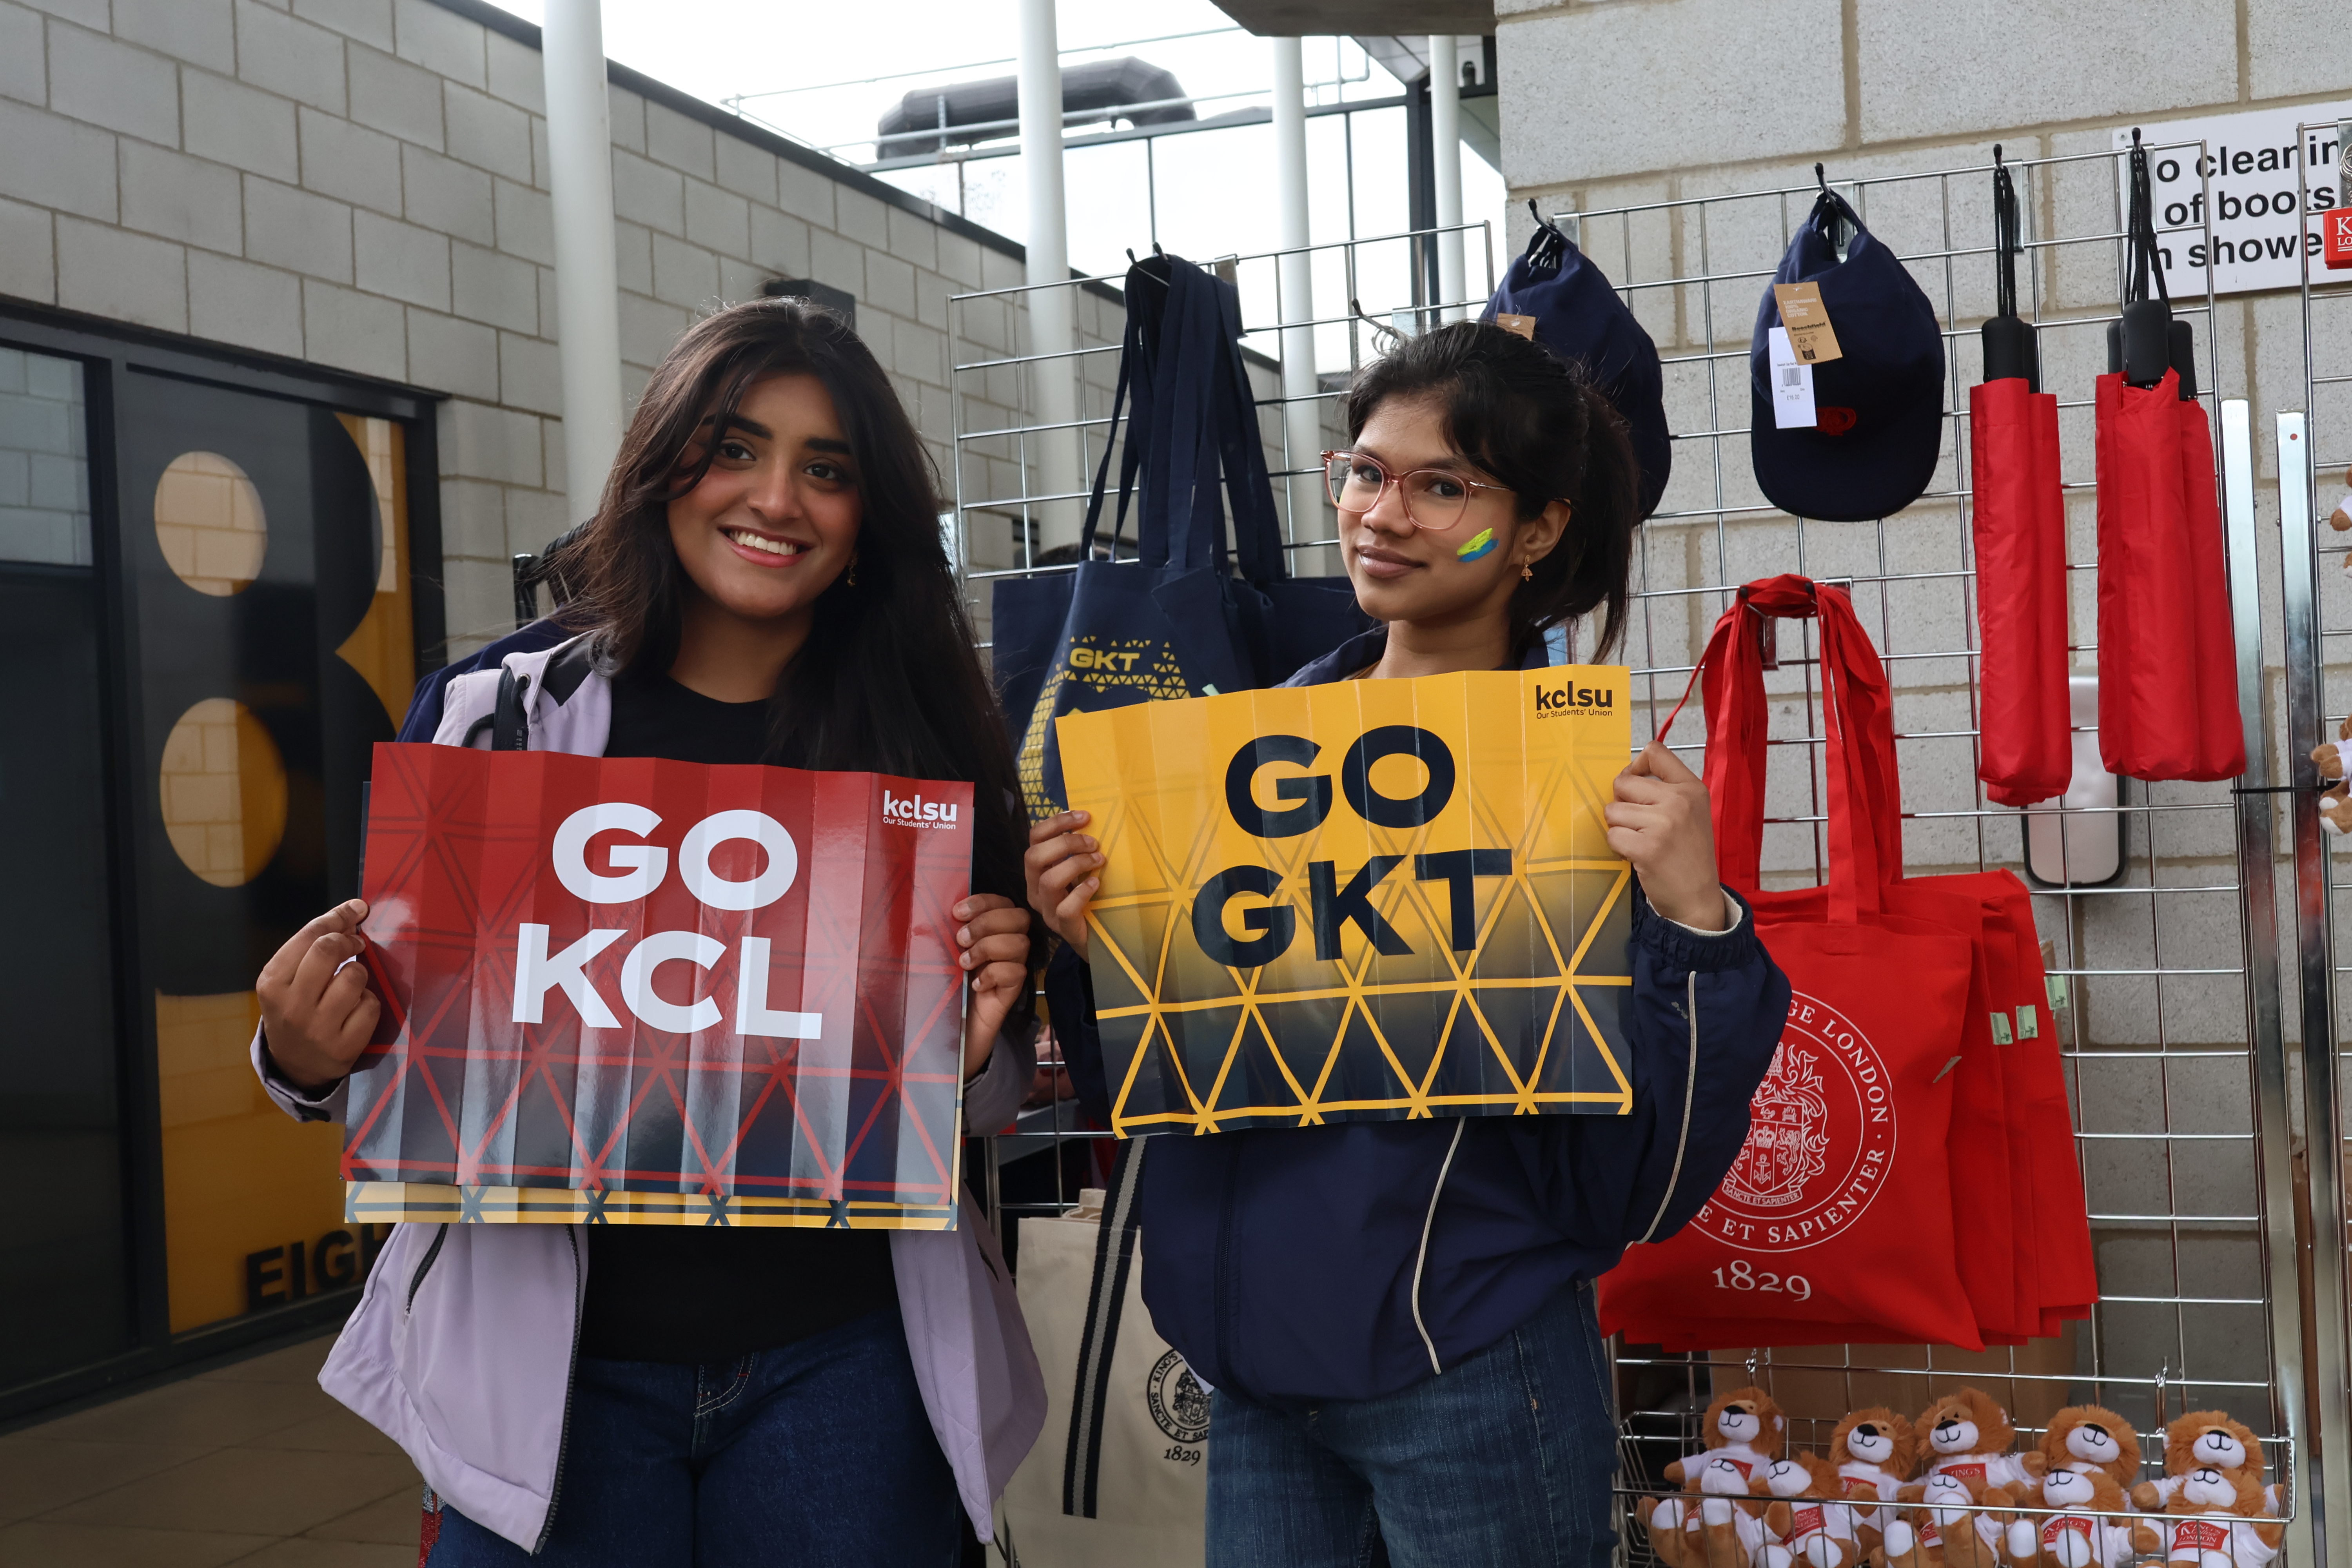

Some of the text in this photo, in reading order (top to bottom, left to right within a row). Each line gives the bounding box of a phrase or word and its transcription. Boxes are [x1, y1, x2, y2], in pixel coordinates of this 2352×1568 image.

[2157, 136, 2339, 182] o cleanin
[2164, 186, 2335, 226] of boots
[2188, 232, 2323, 268] showe
[1069, 647, 1140, 671] GKT
[1536, 681, 1612, 710] kclsu
[1551, 709, 1586, 717] Students'
[1225, 725, 1455, 838] GO
[884, 790, 957, 822] kclsu
[897, 818, 931, 828] Students'
[552, 802, 798, 911] GO
[1192, 848, 1512, 968] GKT
[512, 922, 822, 1040] KCL
[1822, 1019, 1888, 1123] LONDON
[1722, 1149, 1885, 1244] ET SAPIENTER
[1726, 1186, 1751, 1204] SANCTE
[247, 1223, 398, 1312] EIGH
[1712, 1260, 1811, 1302] 1829
[1153, 1353, 1178, 1383] KING'S
[1151, 1392, 1189, 1439] SANCTE ET
[1164, 1445, 1201, 1466] 1829
